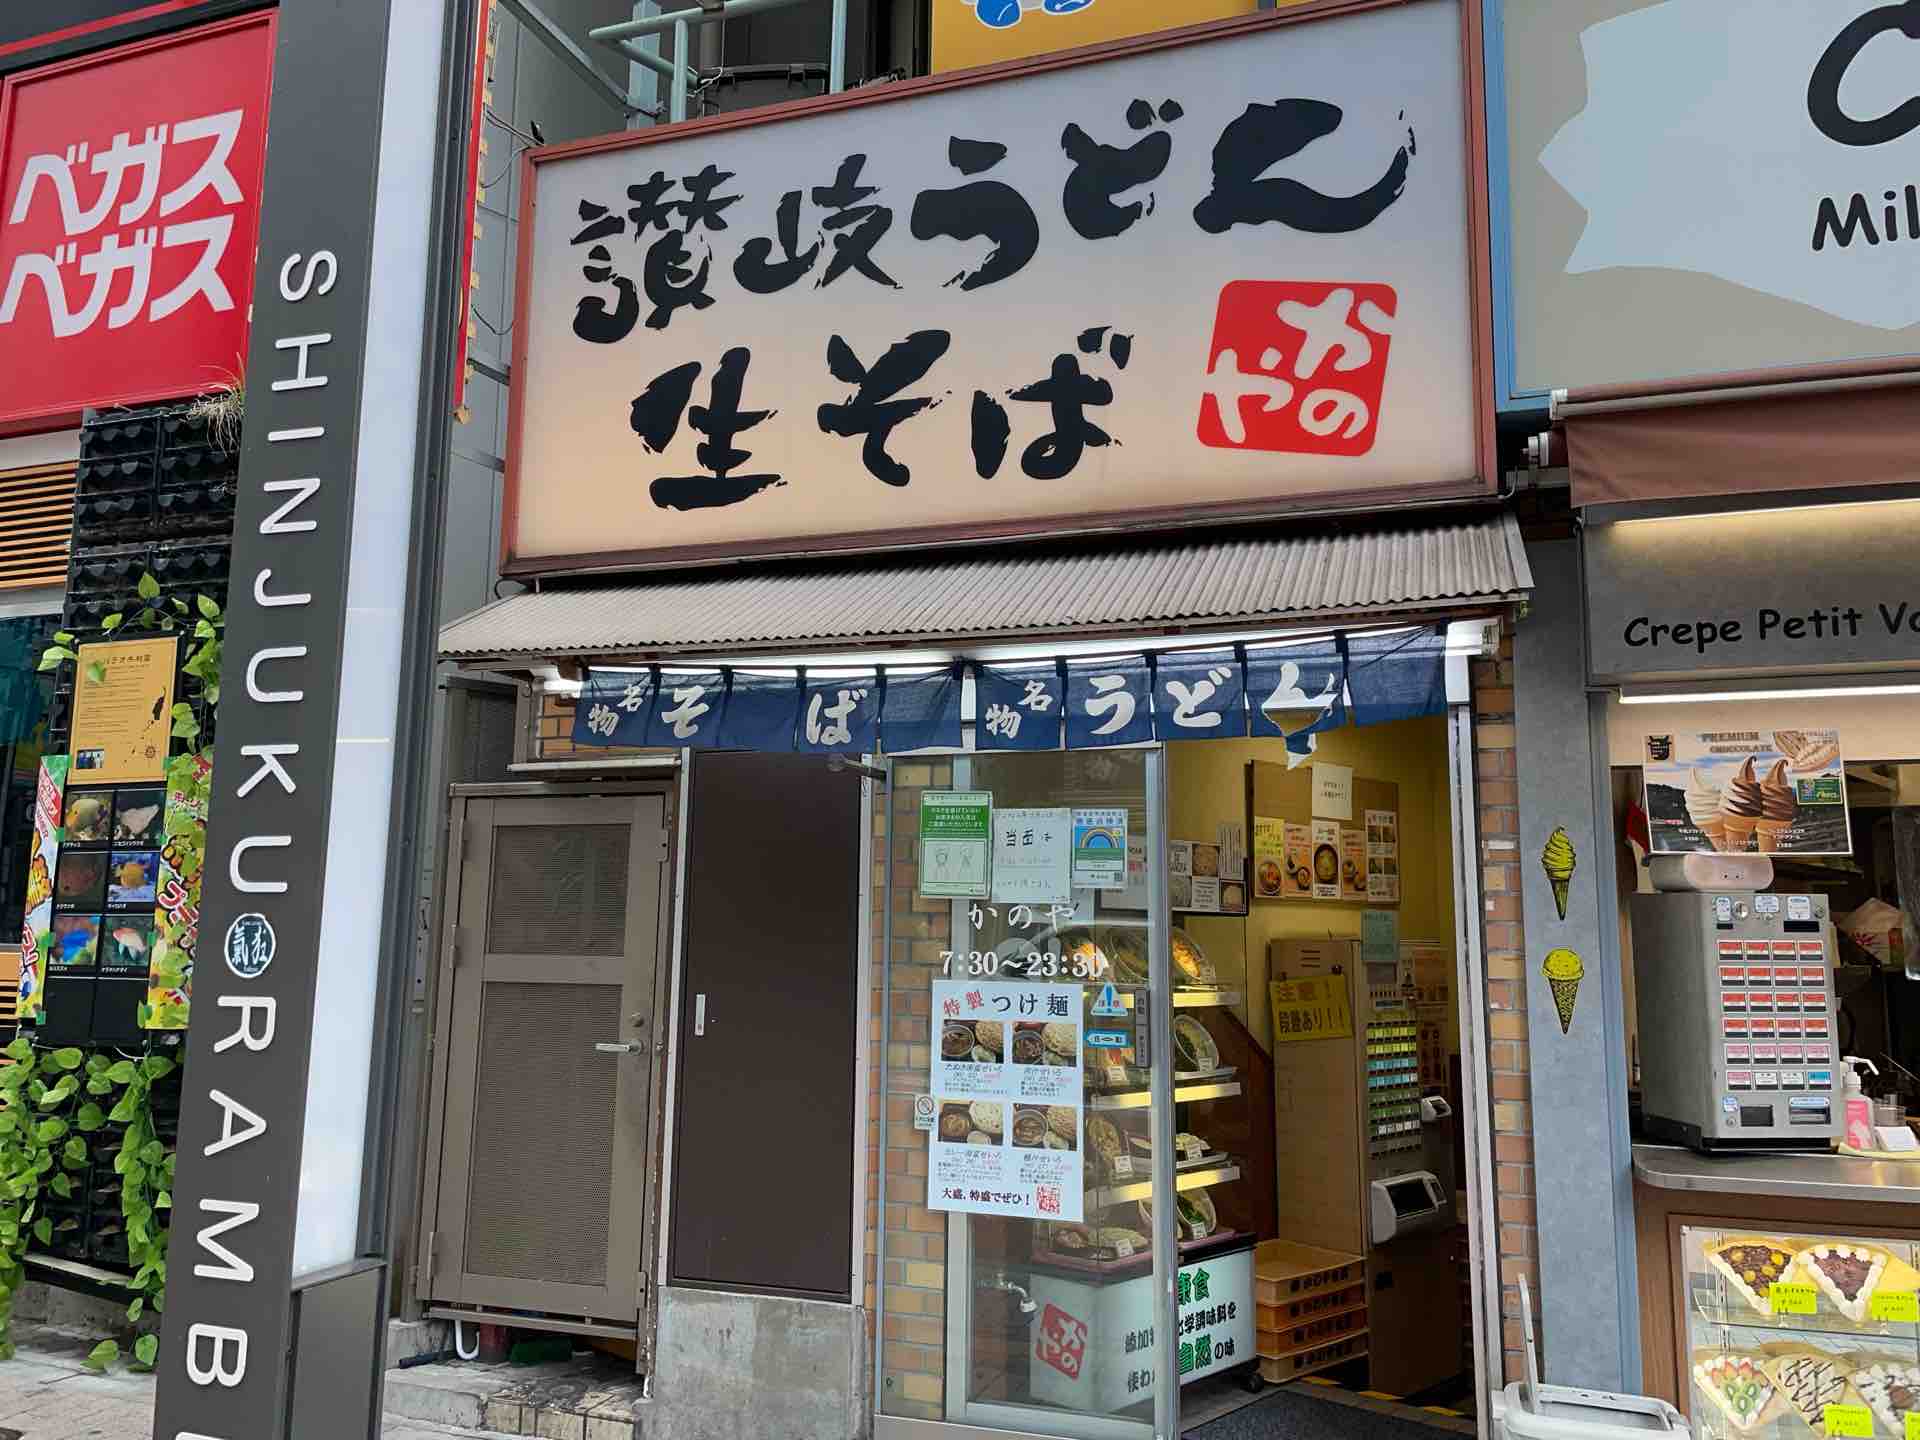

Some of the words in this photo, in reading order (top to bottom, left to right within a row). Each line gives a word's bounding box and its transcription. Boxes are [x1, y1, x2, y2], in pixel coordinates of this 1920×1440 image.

[9, 109, 244, 237] ベガス
[0, 214, 235, 338] ベガス
[630, 326, 1134, 511] 生そば
[229, 249, 338, 894] SHINJUKU
[1623, 616, 1743, 653] Crepe
[1758, 606, 1863, 640] Petit
[661, 685, 868, 745] そば
[1085, 661, 1338, 735] うどん
[968, 902, 1081, 933] かのや
[1127, 1368, 1155, 1393] 使わ
